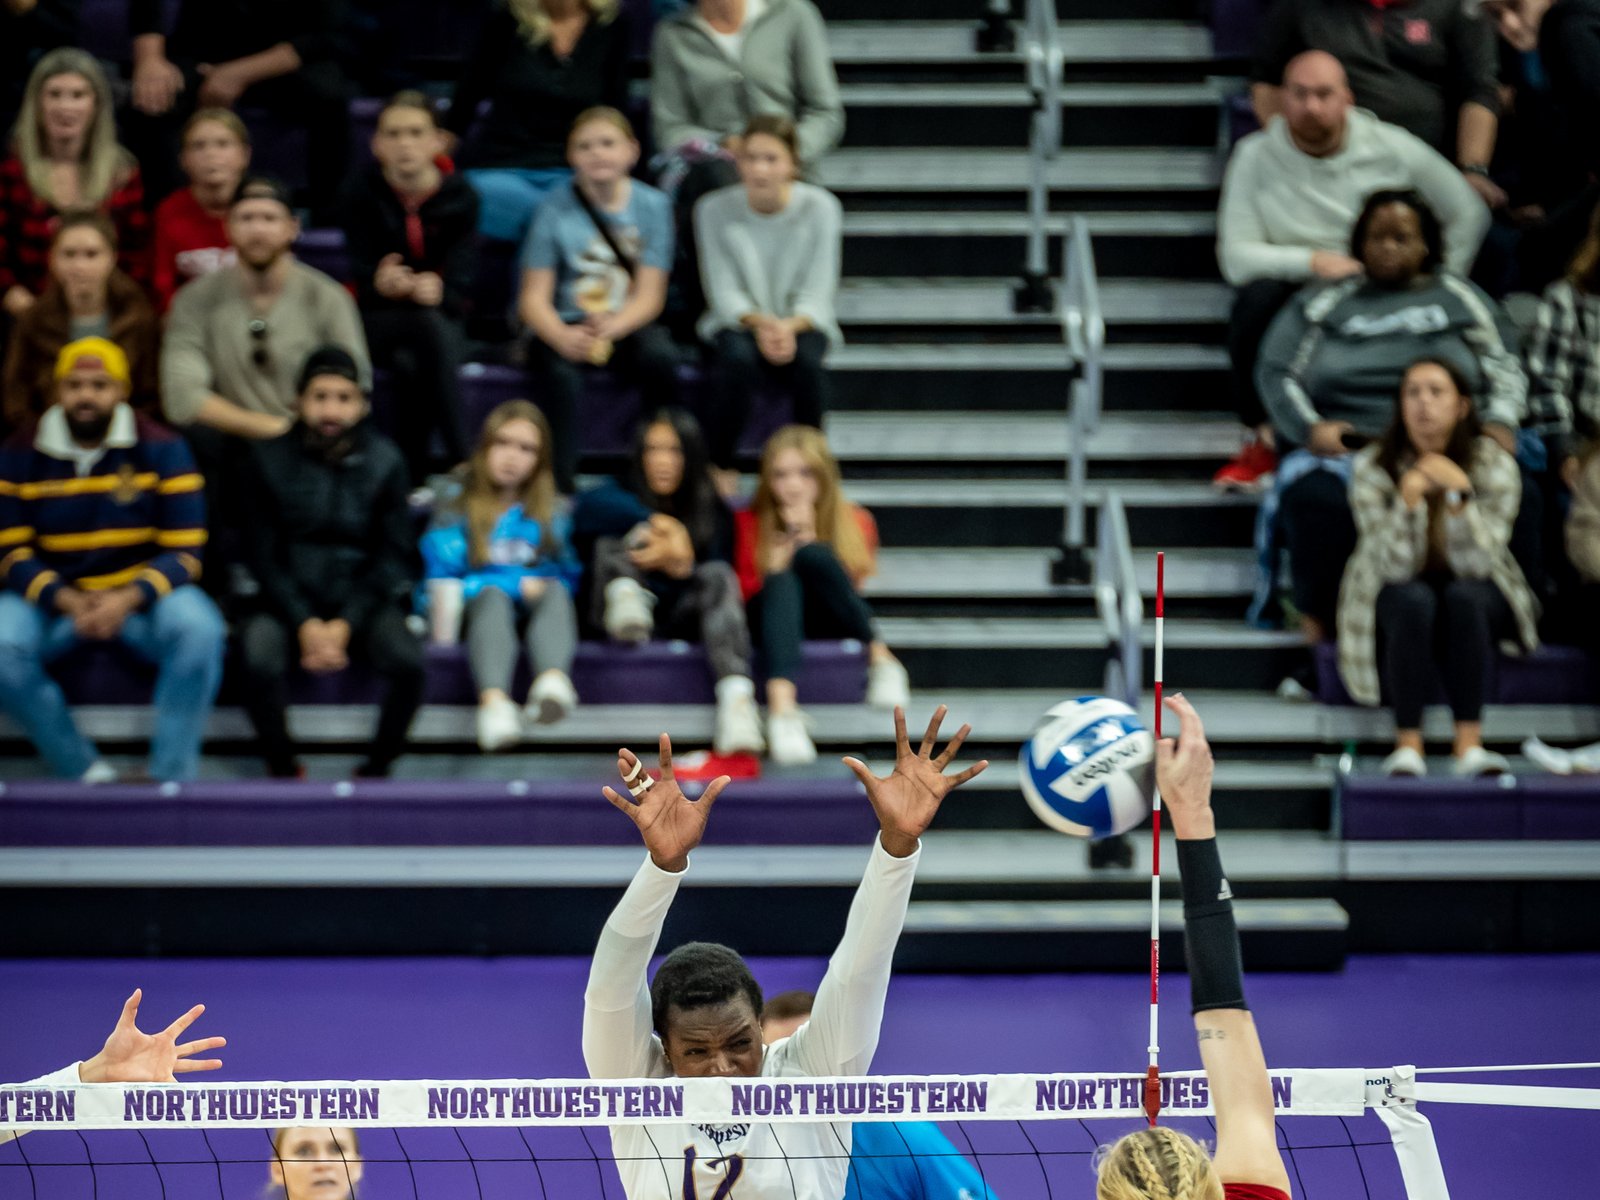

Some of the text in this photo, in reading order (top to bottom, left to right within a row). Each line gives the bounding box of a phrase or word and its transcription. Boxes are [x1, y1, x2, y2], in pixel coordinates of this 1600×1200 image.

[123, 1087, 380, 1121] NORTHWESTERN
[427, 1085, 684, 1119] NORTHWESTERN
[731, 1081, 988, 1116] NORTHWESTERN
[1035, 1077, 1292, 1111] NORTHWESN
